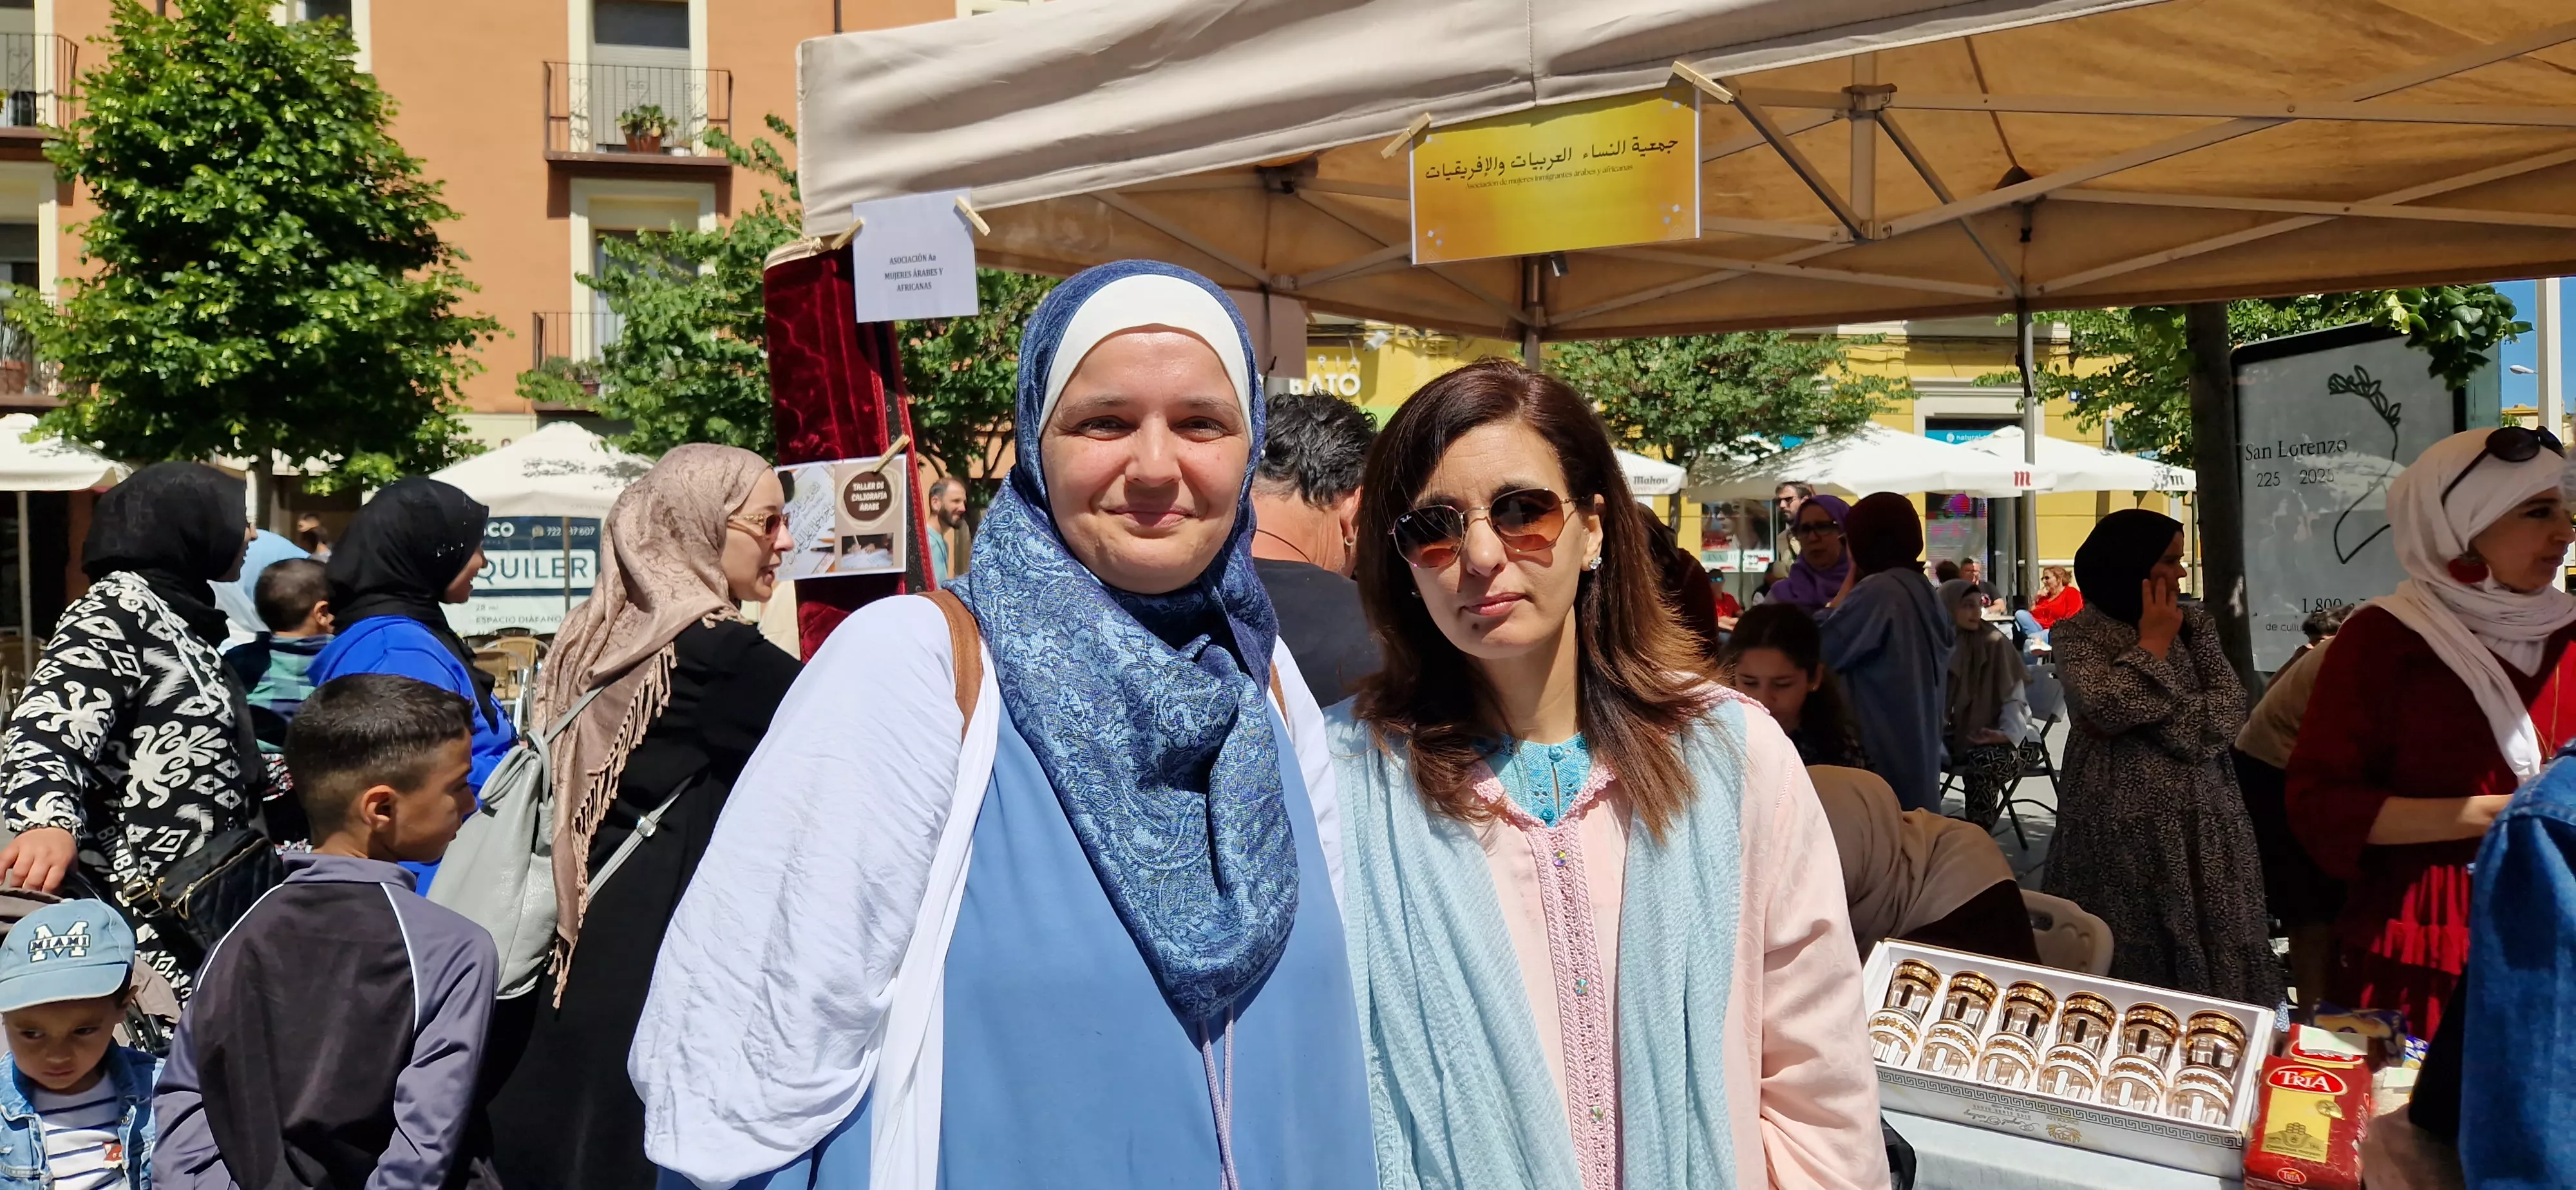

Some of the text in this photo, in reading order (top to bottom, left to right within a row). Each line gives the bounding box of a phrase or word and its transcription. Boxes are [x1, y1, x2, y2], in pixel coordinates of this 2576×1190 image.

[1425, 137, 1678, 181] جمعية النساء العربيات والإفريقيات
[1508, 176, 1533, 185] mujeres
[1602, 165, 1633, 174] africanas
[889, 253, 927, 265] ASOCIACIÓN
[884, 267, 943, 280] MUJERES ÁRABES Y
[896, 281, 932, 292] AFRICANAS
[1318, 355, 1359, 367] RIA
[2246, 440, 2347, 460] San Lorenzo
[1633, 475, 1668, 485] Mahou
[2257, 468, 2334, 487] 225 2025
[852, 481, 885, 491] TALLER DE
[484, 522, 515, 537] CO
[477, 557, 589, 585] QUILER
[2266, 623, 2277, 631] de
[32, 936, 88, 951] MIAMI
